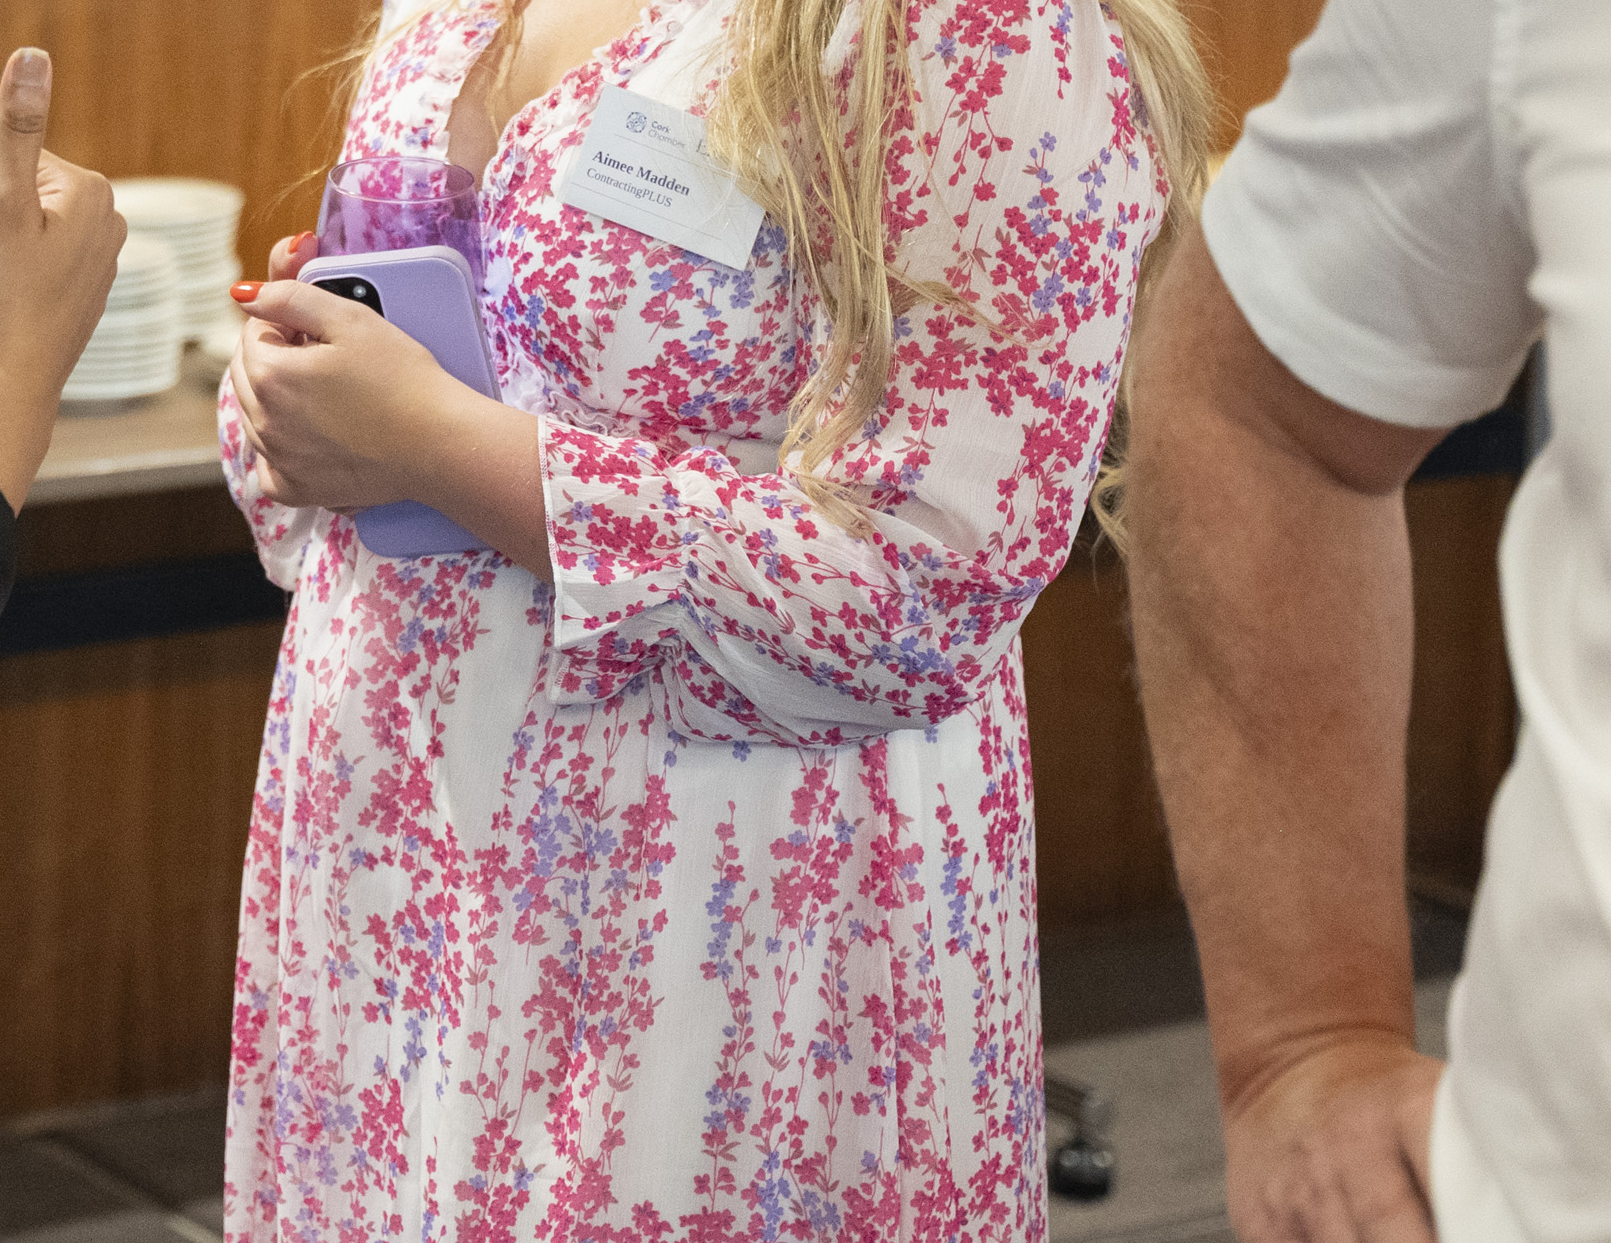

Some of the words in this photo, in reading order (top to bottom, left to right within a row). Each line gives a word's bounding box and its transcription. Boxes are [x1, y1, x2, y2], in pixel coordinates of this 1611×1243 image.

[651, 120, 671, 134] Cork
[586, 167, 674, 208] ContractingPLUS
[592, 151, 634, 175] Aimee
[636, 166, 691, 196] Madden
